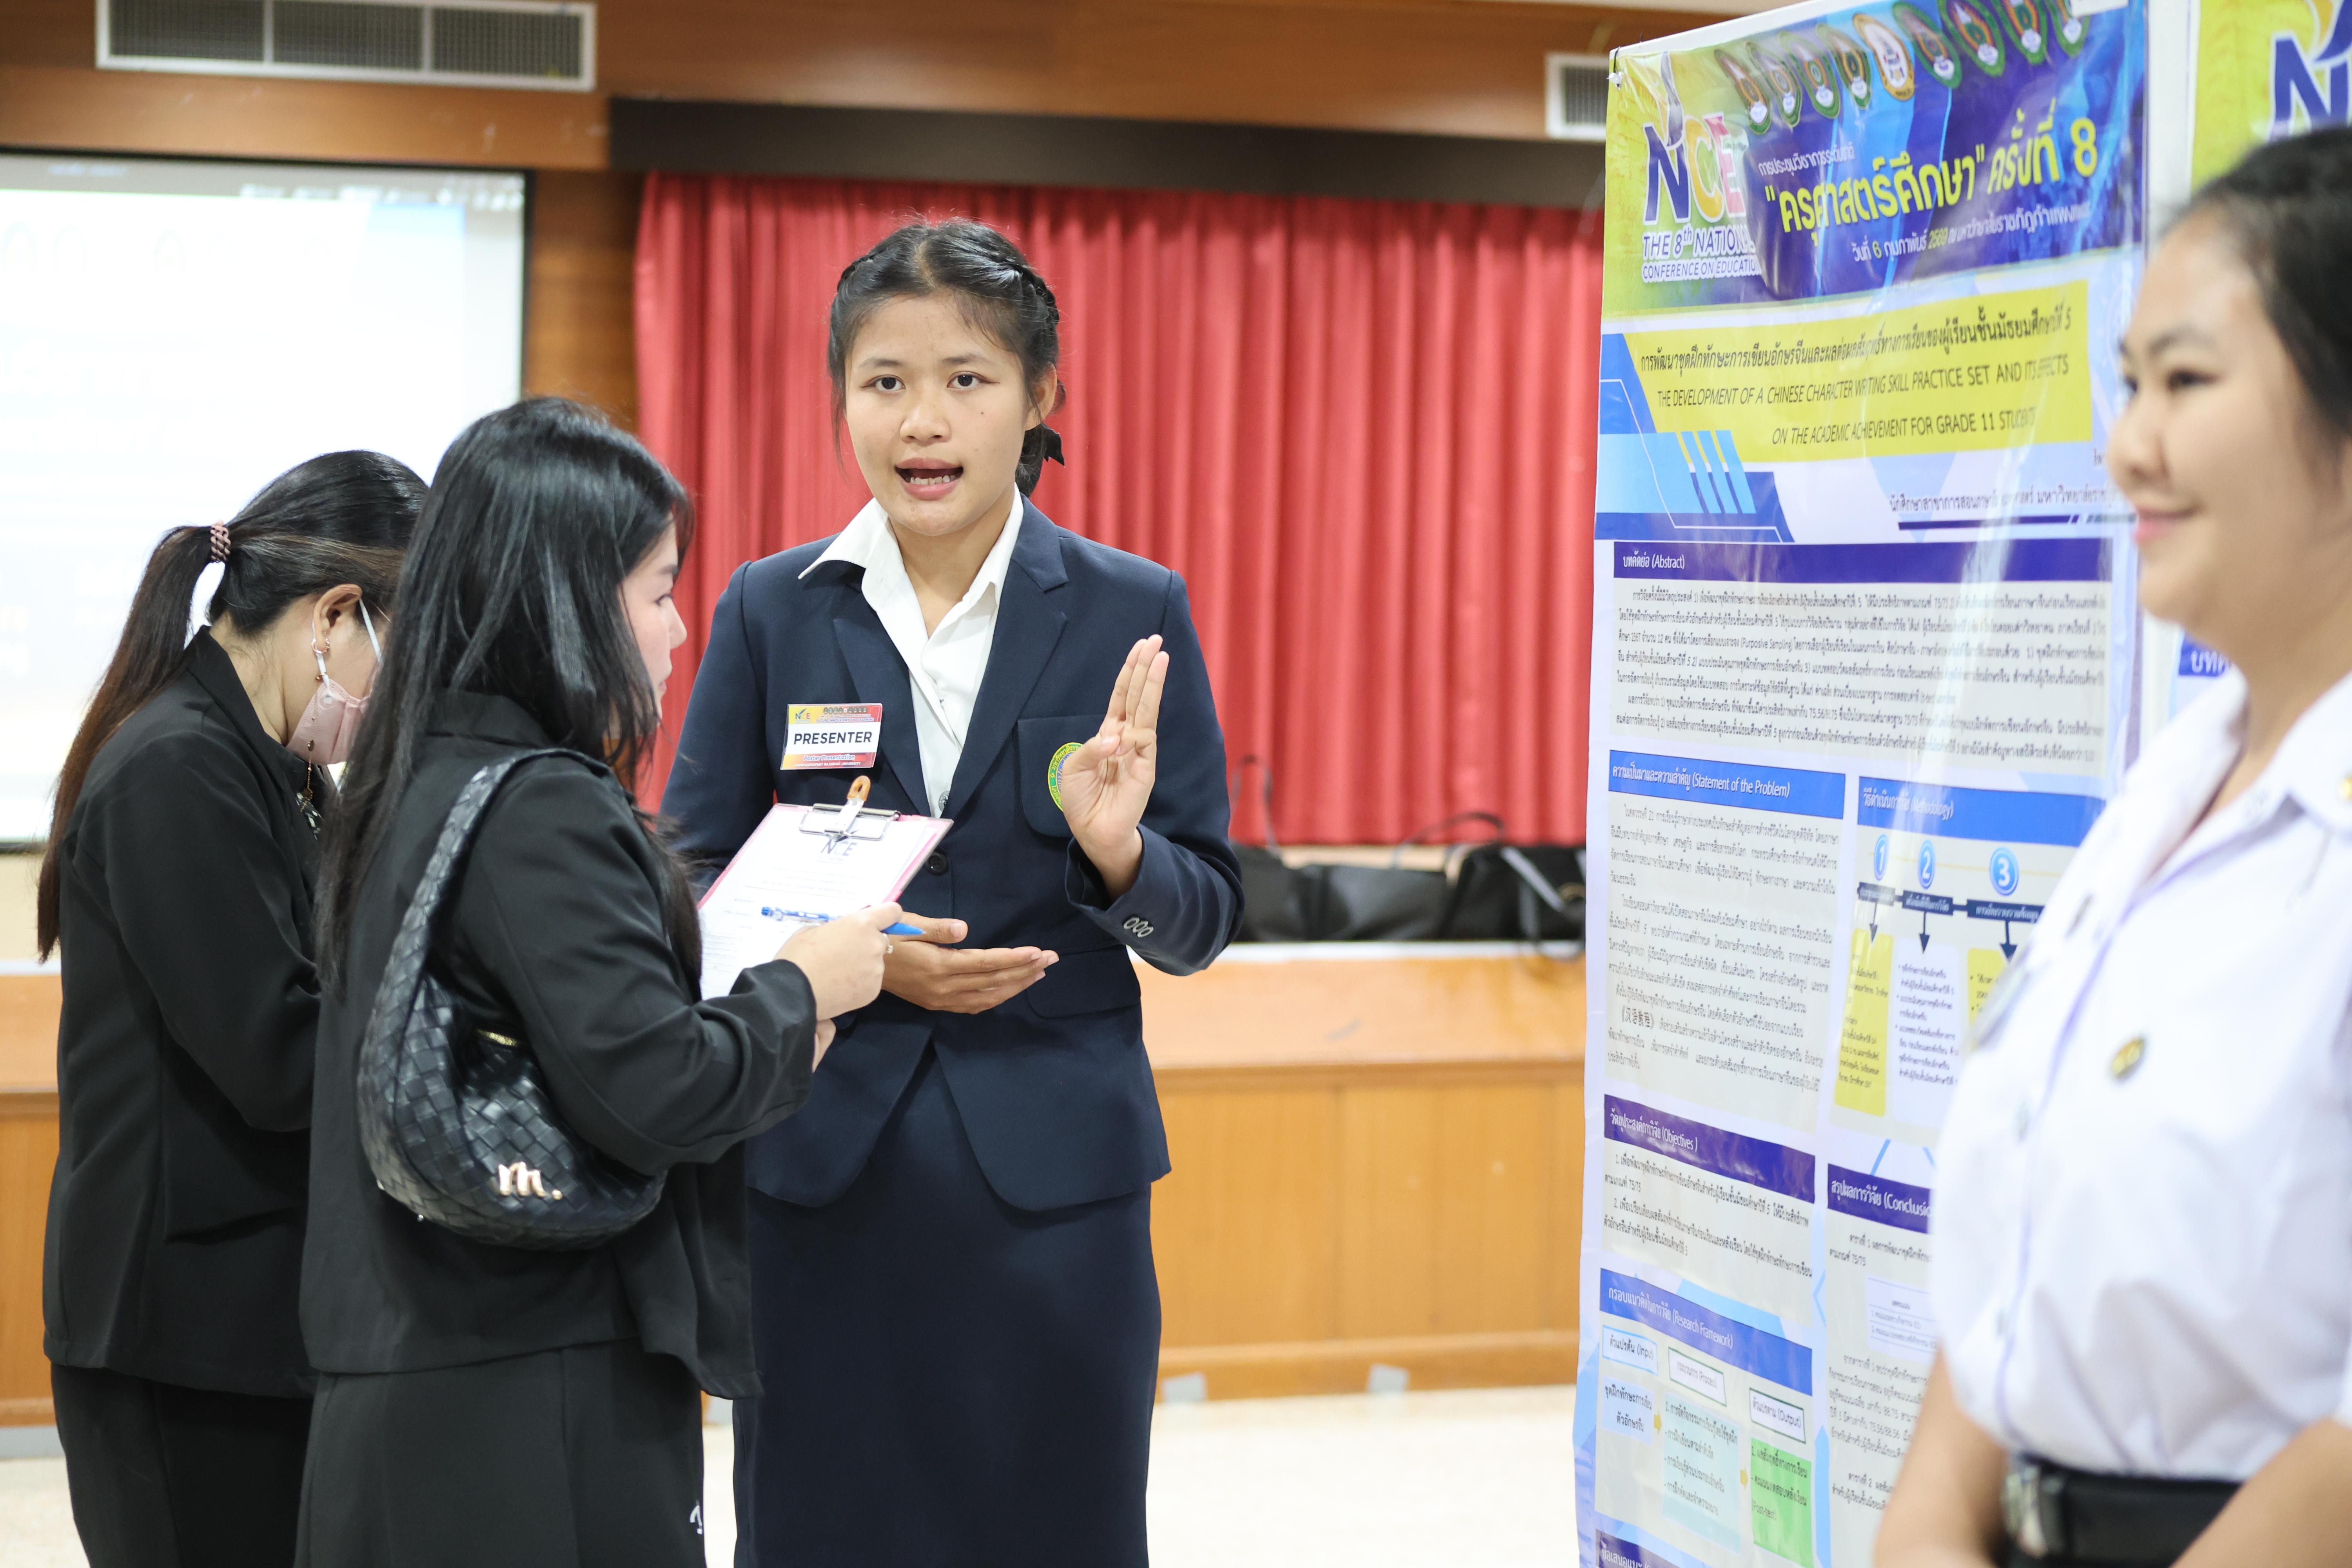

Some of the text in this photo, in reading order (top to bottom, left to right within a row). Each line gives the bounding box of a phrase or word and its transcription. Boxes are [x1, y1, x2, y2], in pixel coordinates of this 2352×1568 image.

[1644, 113, 1746, 224] NCE
[1765, 97, 2097, 247] "ครุศาสตร์ศึกษา" ครั้งที่ 8
[1644, 235, 1671, 257] THE
[1674, 227, 1692, 255] 8th
[1851, 235, 1871, 262] วันที่
[1872, 240, 1882, 259] 6
[1643, 262, 1699, 279] CONFERENCE
[1701, 261, 1713, 274] ON
[2065, 307, 2071, 330] 5
[1658, 390, 1671, 407] THE
[1673, 387, 1738, 407] DEVELOPMENT
[1740, 386, 1755, 404] OF
[1755, 387, 1763, 404] A
[1768, 385, 1804, 404] CHINESE
[1806, 379, 1853, 402] CHARACTER
[1888, 373, 1909, 394] SKILL
[1912, 367, 1962, 390] PRACTICE
[1967, 364, 1991, 386] SET
[1996, 361, 2022, 383] AND
[1772, 427, 1786, 445] ON
[1792, 427, 1808, 445] THE
[1810, 422, 1850, 443] ACADEMIC
[1851, 418, 1907, 440] ACHIEVEMENT
[1911, 416, 1933, 435] FOR
[1936, 413, 1976, 433] GRADE
[1982, 412, 1995, 431] 11
[1623, 550, 1685, 570] บทคัดย่อ (Abstract)
[1740, 637, 1768, 650] (Purposive
[1769, 639, 1793, 652] Sampling)
[794, 731, 872, 745] PRESENTER
[1613, 761, 1791, 799] ความเป็นมาและความสำคัญ (Statement of the Problem)
[1878, 844, 1886, 872] 1
[1922, 850, 1931, 880] 2
[1998, 857, 2011, 887] 3
[1662, 1128, 1694, 1151] (Objectives
[1629, 1179, 1641, 1192] 75/75
[1673, 1308, 1699, 1334] (Research
[1700, 1319, 1733, 1350] Framework)
[1778, 1408, 1801, 1428] (Output)
